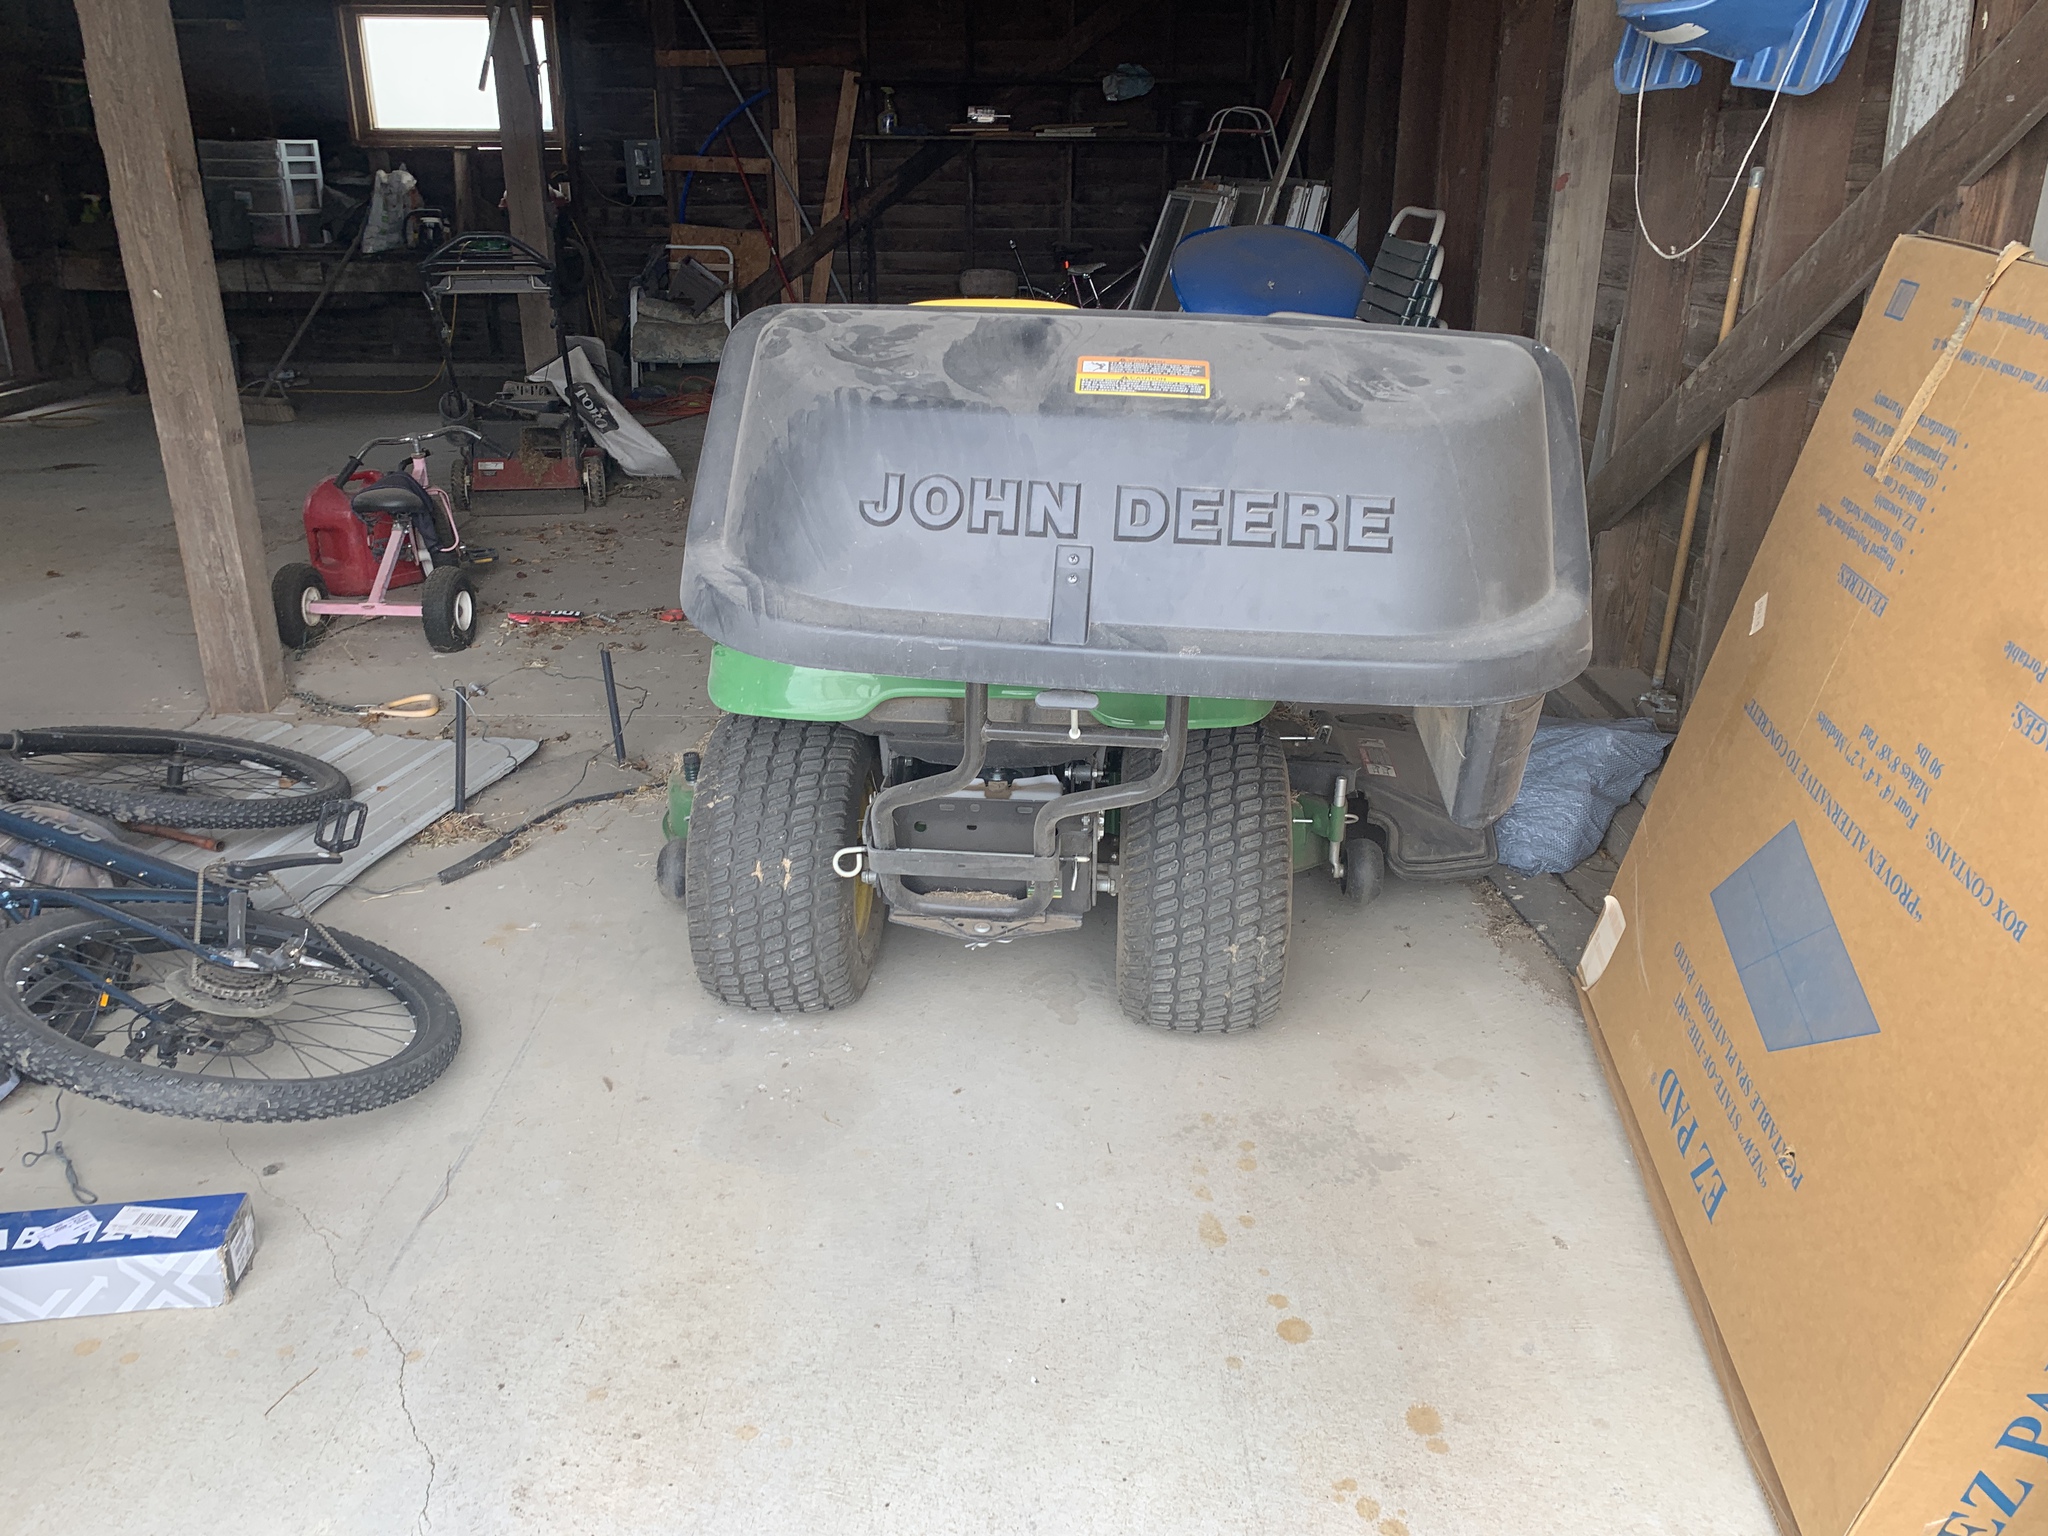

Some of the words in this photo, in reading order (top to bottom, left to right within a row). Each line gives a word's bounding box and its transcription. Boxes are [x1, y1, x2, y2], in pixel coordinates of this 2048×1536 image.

[574, 385, 608, 429] TORO
[1873, 390, 1904, 420] Warranty
[1901, 460, 1938, 489] (Optional
[859, 472, 1082, 540] JOHN
[1113, 484, 1396, 554] DEERE
[1817, 504, 1838, 526] Plastic
[1840, 497, 1862, 520] Surface
[1873, 494, 1904, 520] Assembly
[1902, 513, 1918, 532] EZ
[1832, 516, 1870, 553] Polyethylene
[1859, 512, 1891, 542] Resistant
[1890, 531, 1906, 552] Slip
[1868, 544, 1896, 572] Rugged
[1838, 563, 1889, 618] FEATURES:
[2003, 640, 2048, 684] Portable
[1816, 711, 1847, 752] Modules
[1859, 724, 1879, 750] Pad
[2011, 701, 2048, 752] GES:
[1786, 750, 1800, 774] TO
[1915, 743, 1932, 767] lbs
[1928, 757, 1944, 780] 90
[1900, 763, 1932, 804] Makes
[1798, 766, 1869, 852] ALTERNATIVE
[1893, 796, 1919, 830] Four
[1926, 828, 1994, 907] CONTAINS:
[1992, 898, 2028, 943] BOX
[1674, 941, 1696, 985] PATIO
[1695, 984, 1738, 1066] PLATFORM
[1674, 994, 1741, 1131] STATE-OF-THE-ART
[1736, 1061, 1753, 1095] SPA
[1657, 1068, 1699, 1157] PAD
[1690, 1142, 1728, 1223] EZ
[1937, 1470, 2034, 1536] EZ
